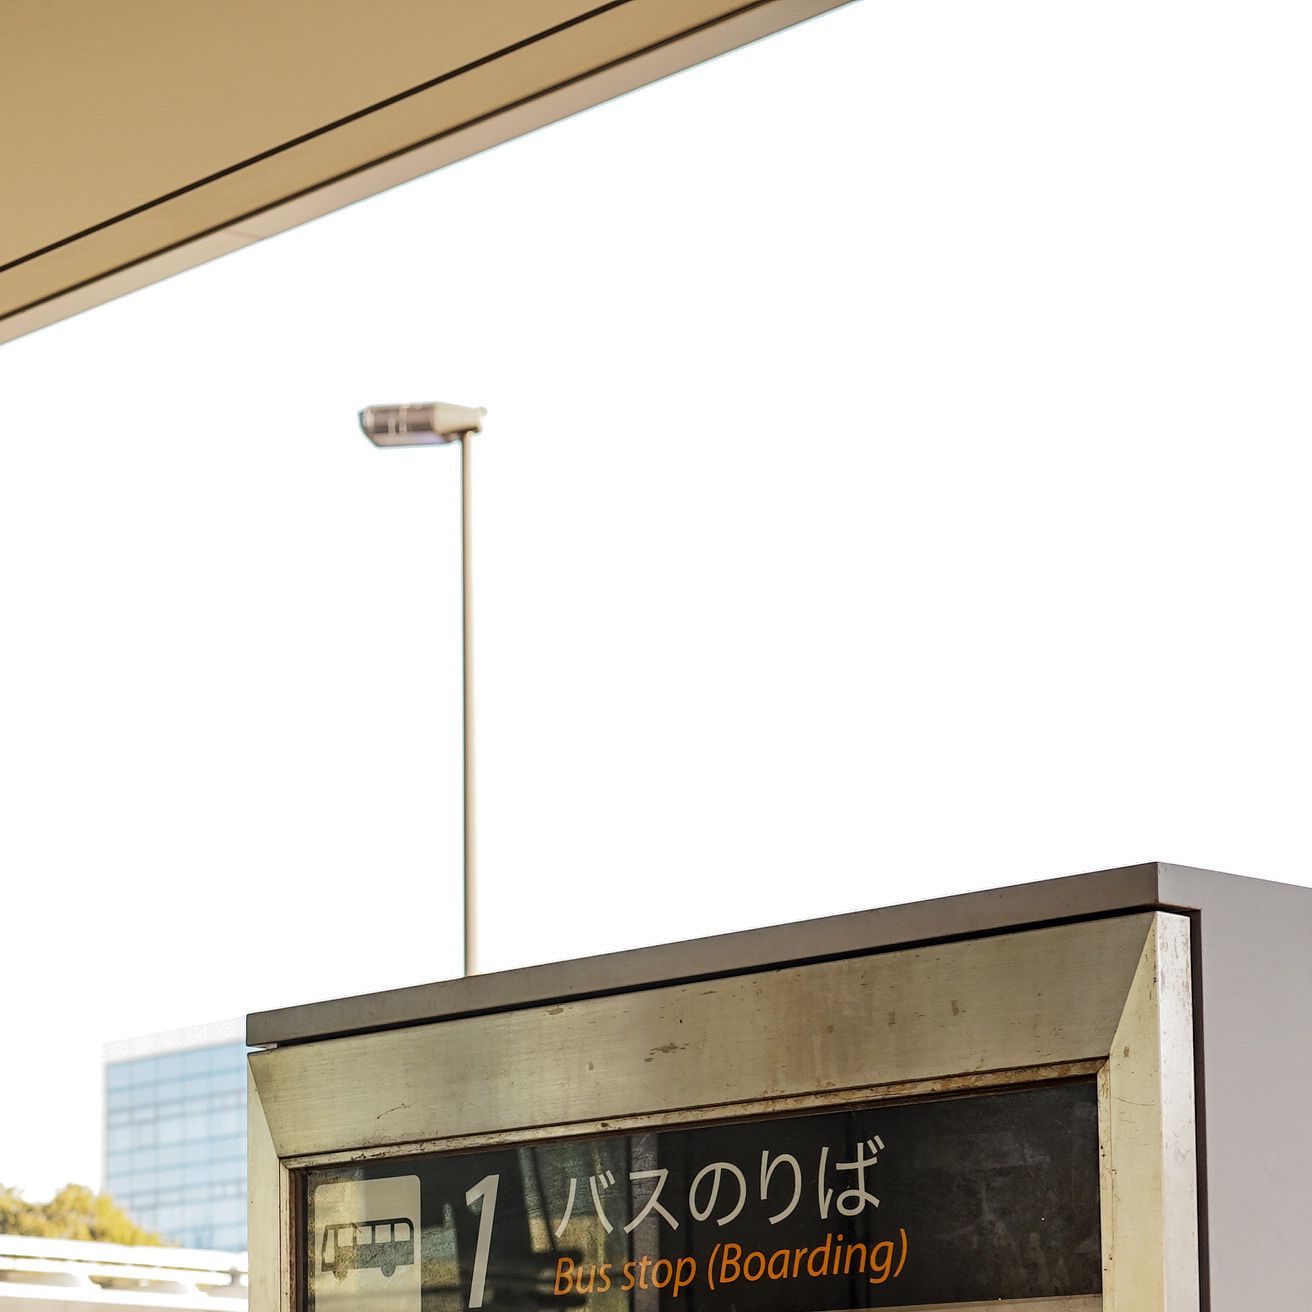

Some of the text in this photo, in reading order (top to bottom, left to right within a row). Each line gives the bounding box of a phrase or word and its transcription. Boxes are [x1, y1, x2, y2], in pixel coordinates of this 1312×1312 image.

[555, 1135, 885, 1237] バスのりば
[465, 1174, 501, 1309] 1
[554, 1229, 909, 1297] Bus stop (Boarding)
